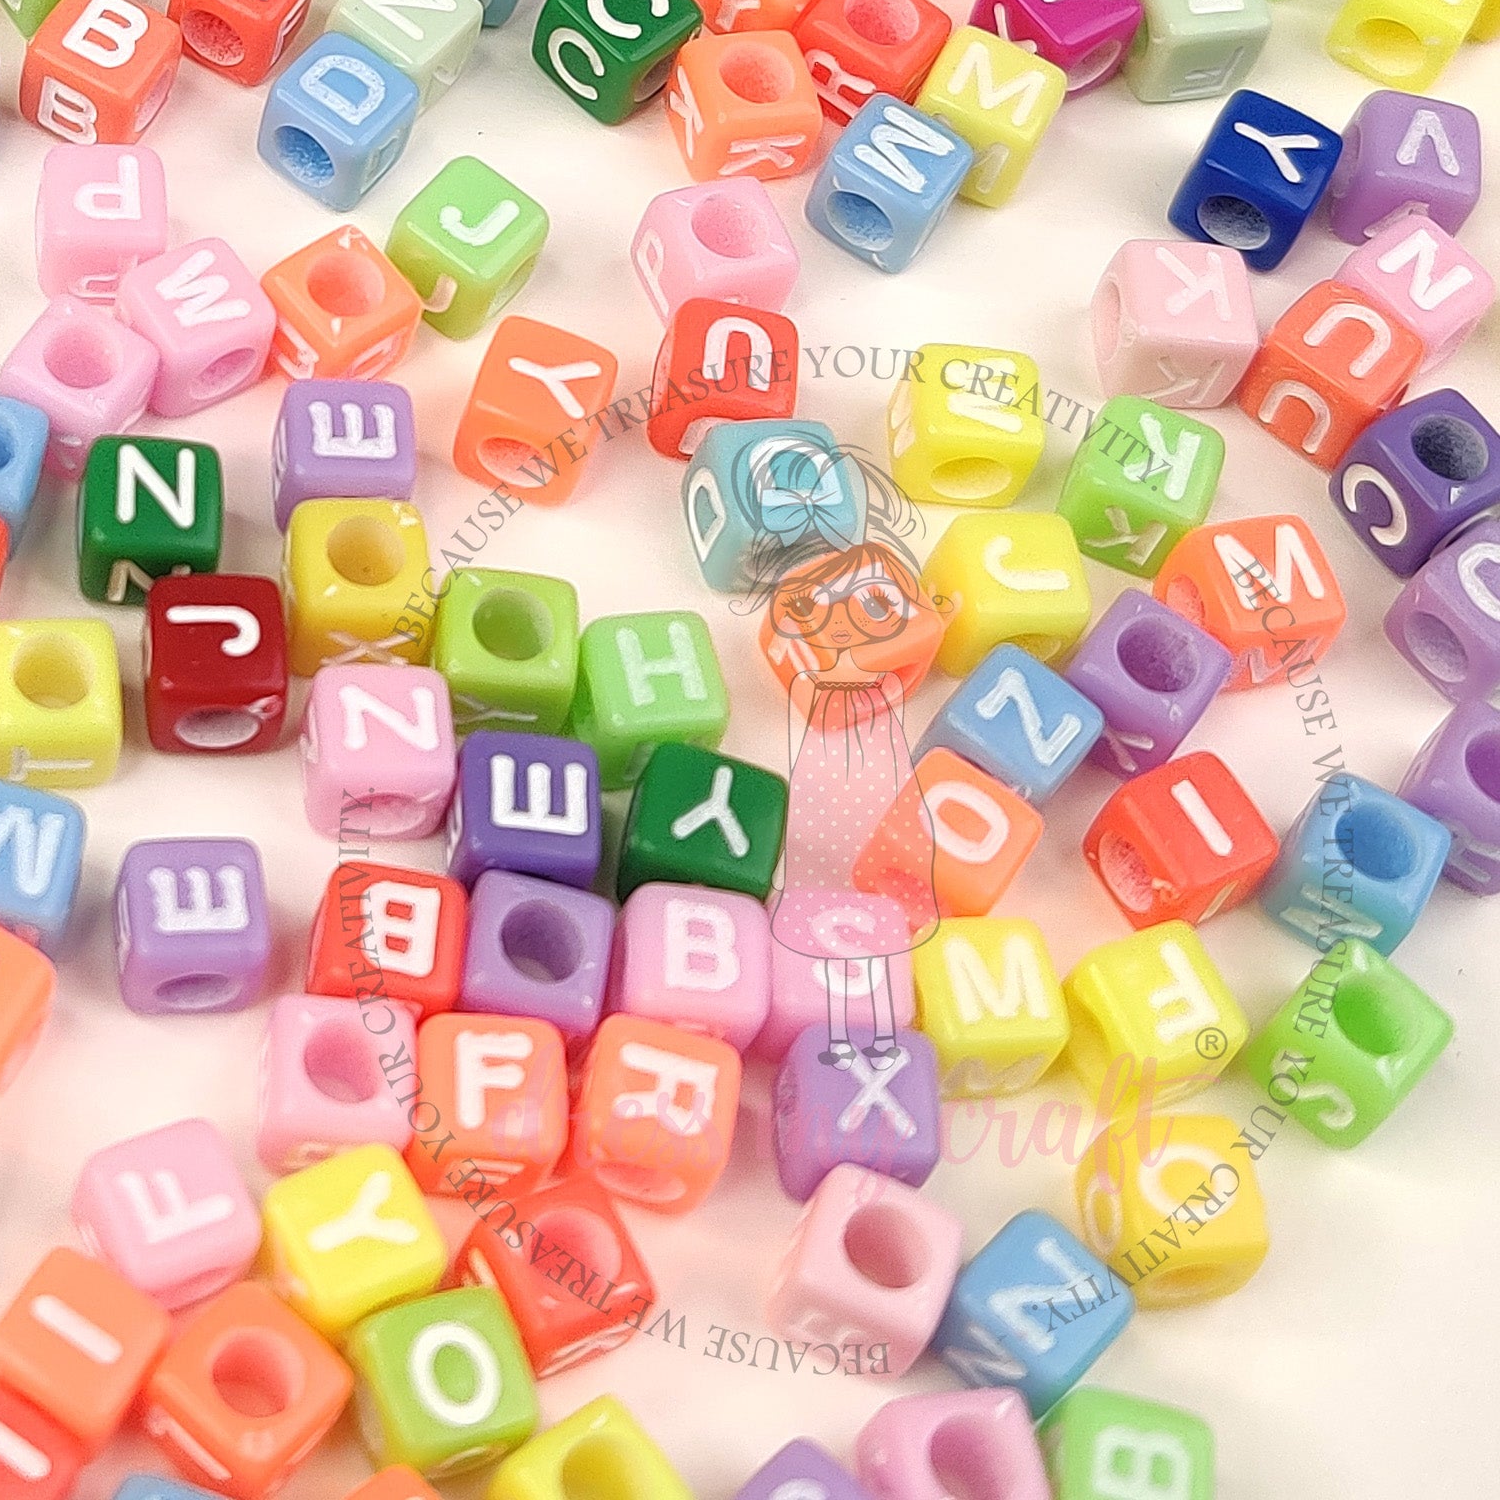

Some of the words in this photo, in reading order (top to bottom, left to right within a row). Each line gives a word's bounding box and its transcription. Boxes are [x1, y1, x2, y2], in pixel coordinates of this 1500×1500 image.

[300, 54, 386, 126] D
[549, 26, 605, 101] C
[1234, 121, 1321, 182] Y
[1396, 109, 1460, 177] V
[439, 199, 521, 246] J
[703, 317, 773, 392] U
[1304, 303, 1391, 378] U
[508, 357, 601, 419] Y
[309, 401, 396, 459] E
[116, 444, 196, 530] N
[1341, 464, 1407, 546] C
[165, 604, 261, 657] J
[619, 623, 701, 704] H
[491, 754, 589, 833] E
[671, 765, 750, 857] Y
[148, 865, 250, 931] E
[360, 881, 441, 976] B
[664, 899, 739, 990] B
[456, 1031, 534, 1129] F
[616, 1041, 719, 1135] R
[308, 1171, 420, 1251] Y
[411, 1323, 501, 1423] O
